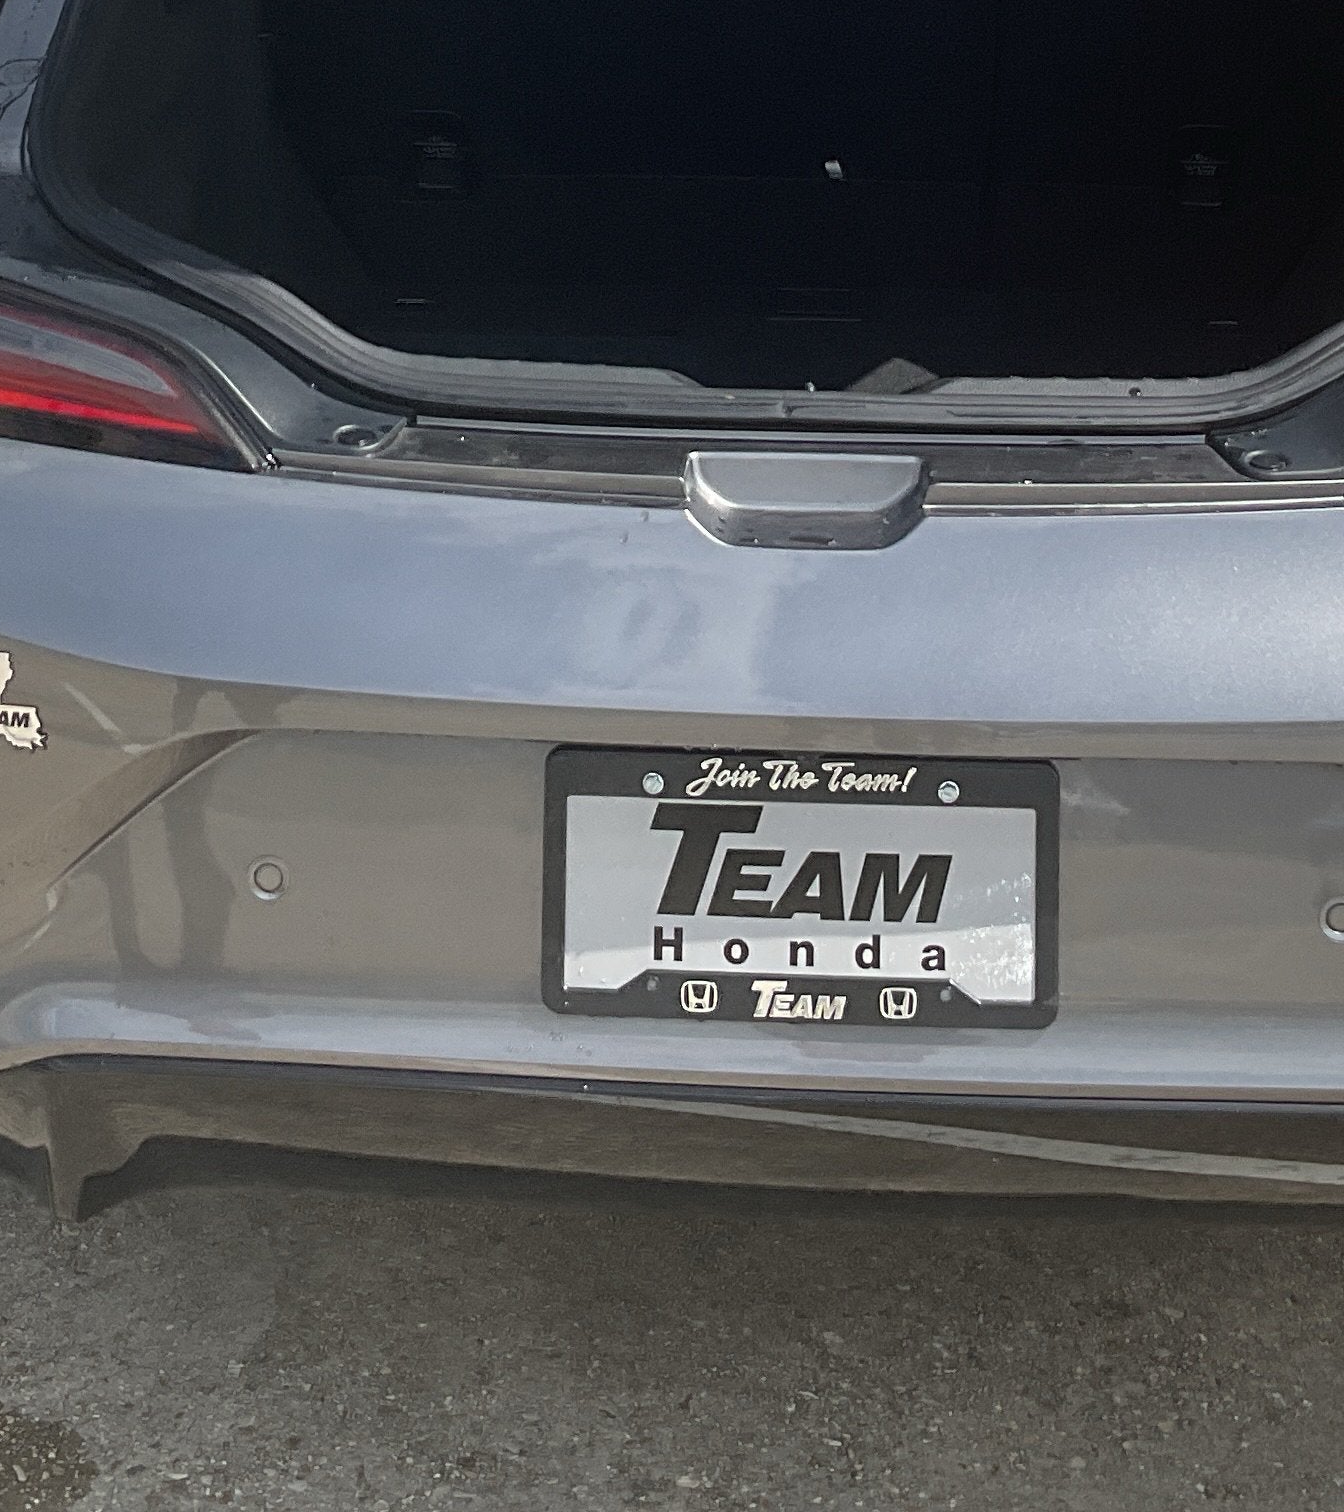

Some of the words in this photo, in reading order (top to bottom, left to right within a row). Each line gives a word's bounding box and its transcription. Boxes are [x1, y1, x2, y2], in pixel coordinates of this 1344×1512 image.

[686, 757, 760, 796] Join
[762, 759, 820, 791] The
[821, 761, 918, 793] Team!
[650, 802, 953, 924] TEAM
[653, 926, 947, 971] Honda
[751, 980, 847, 1020] TEAM
